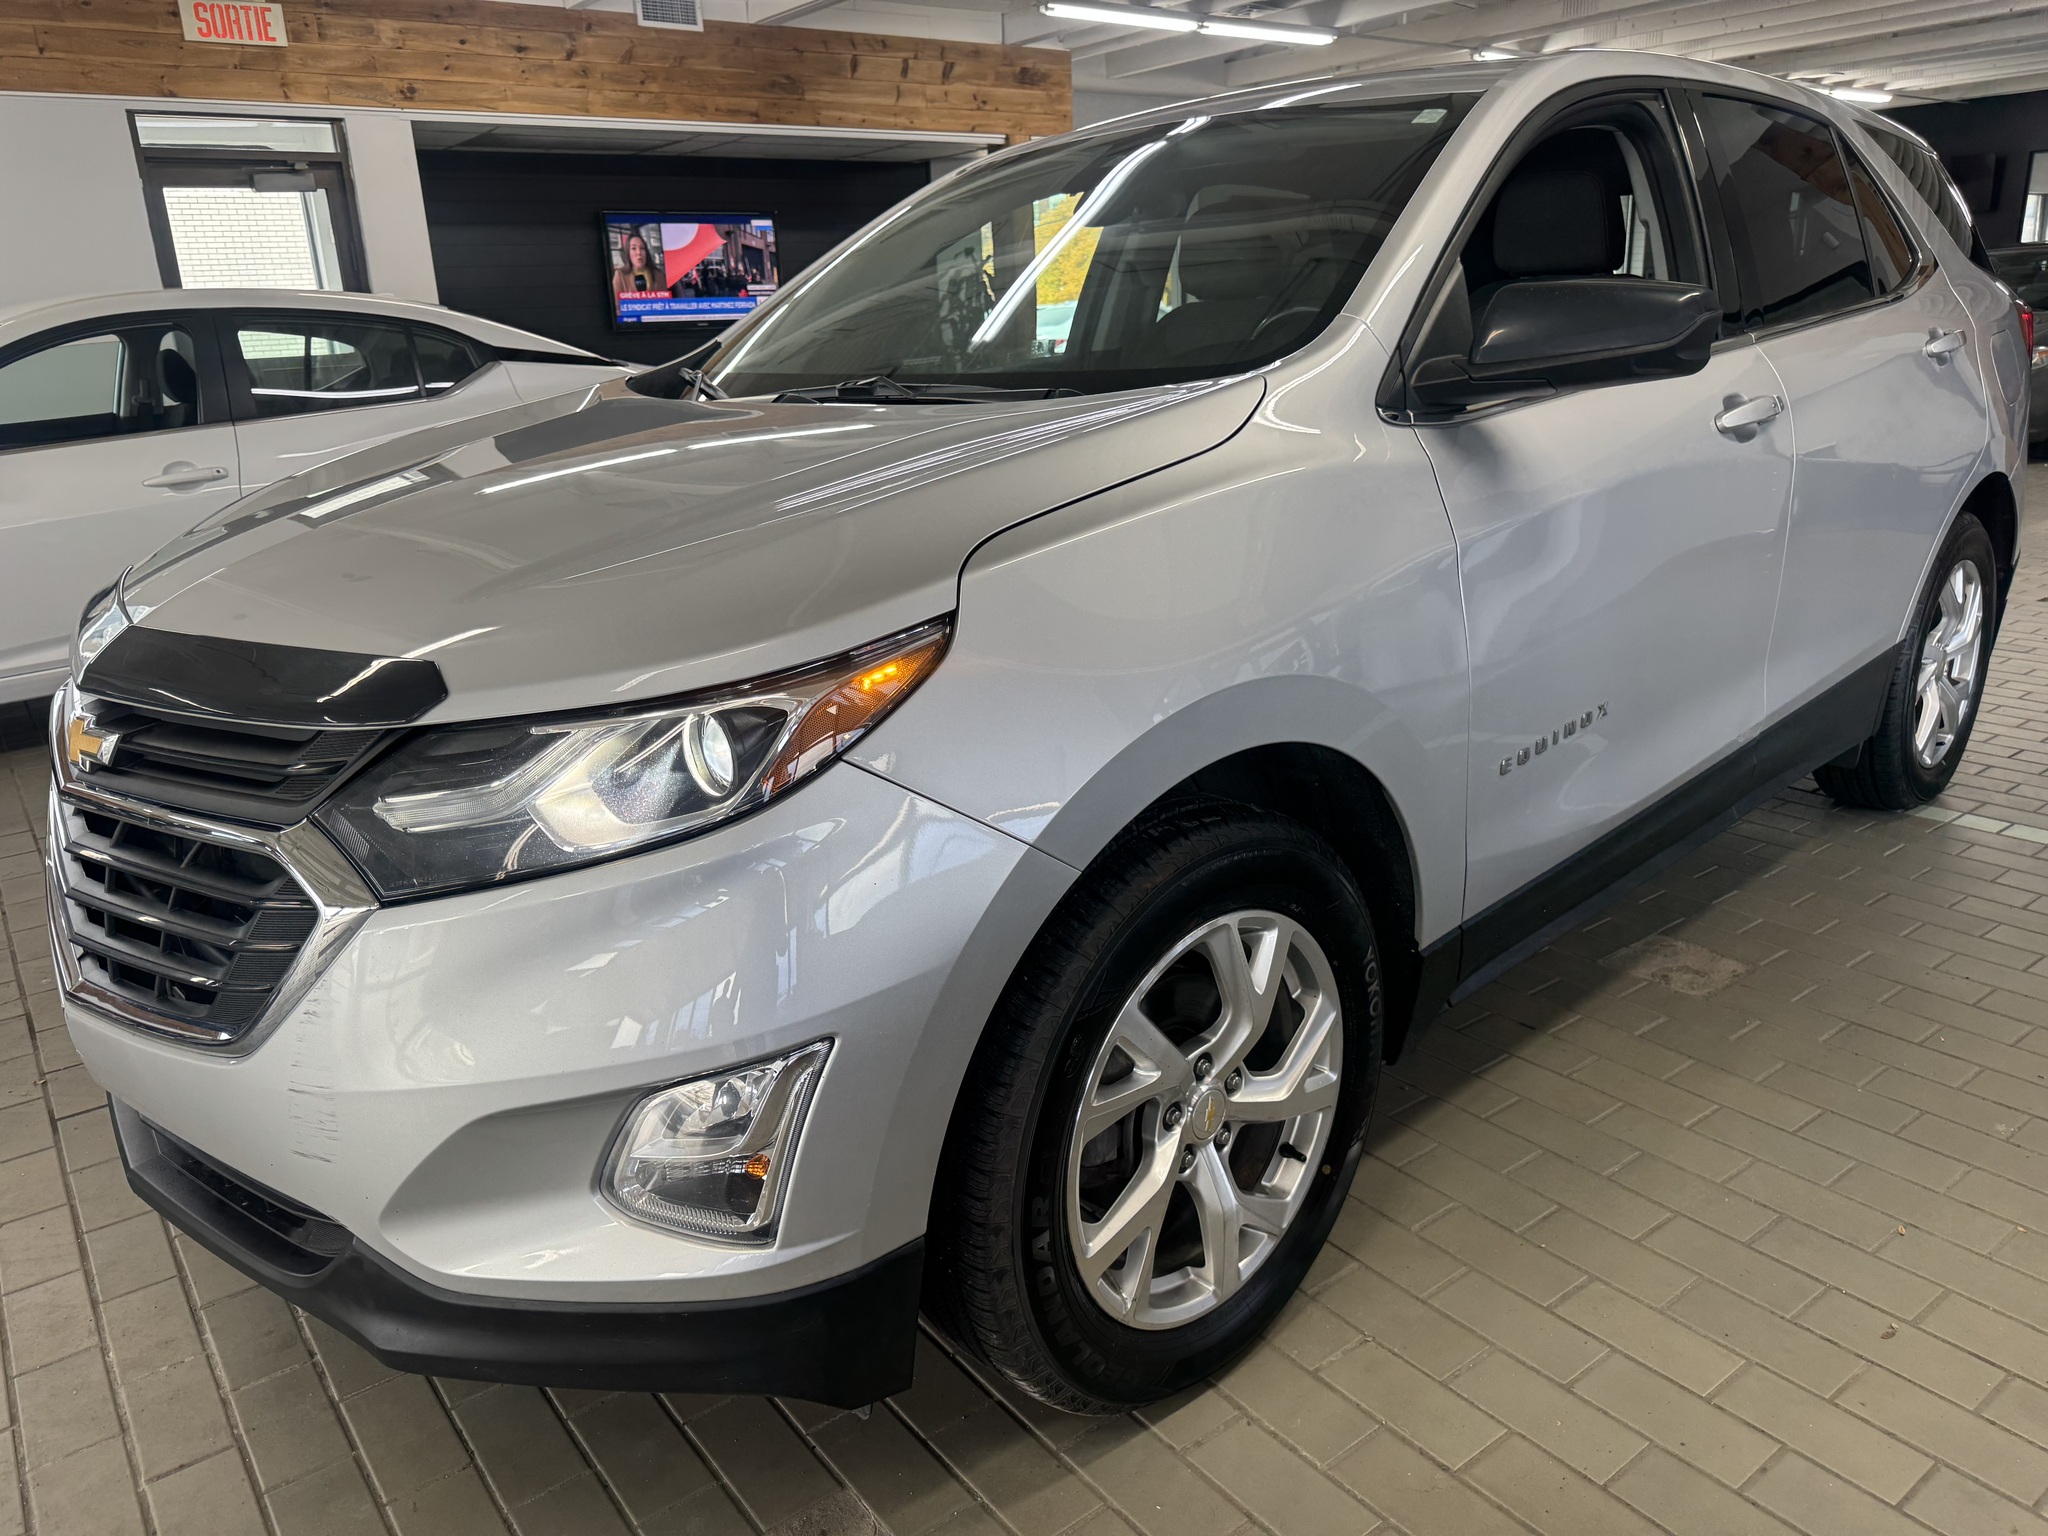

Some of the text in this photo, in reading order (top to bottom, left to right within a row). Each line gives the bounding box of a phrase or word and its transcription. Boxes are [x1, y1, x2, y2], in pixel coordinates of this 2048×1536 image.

[193, 2, 277, 42] SORTIE
[619, 291, 640, 299] GRÈVE
[620, 302, 627, 311] LE
[628, 302, 652, 311] SYNDICAT
[670, 301, 697, 310] TRAVAILLER
[698, 301, 710, 309] AVEC
[1499, 701, 1609, 776] EQUINOX
